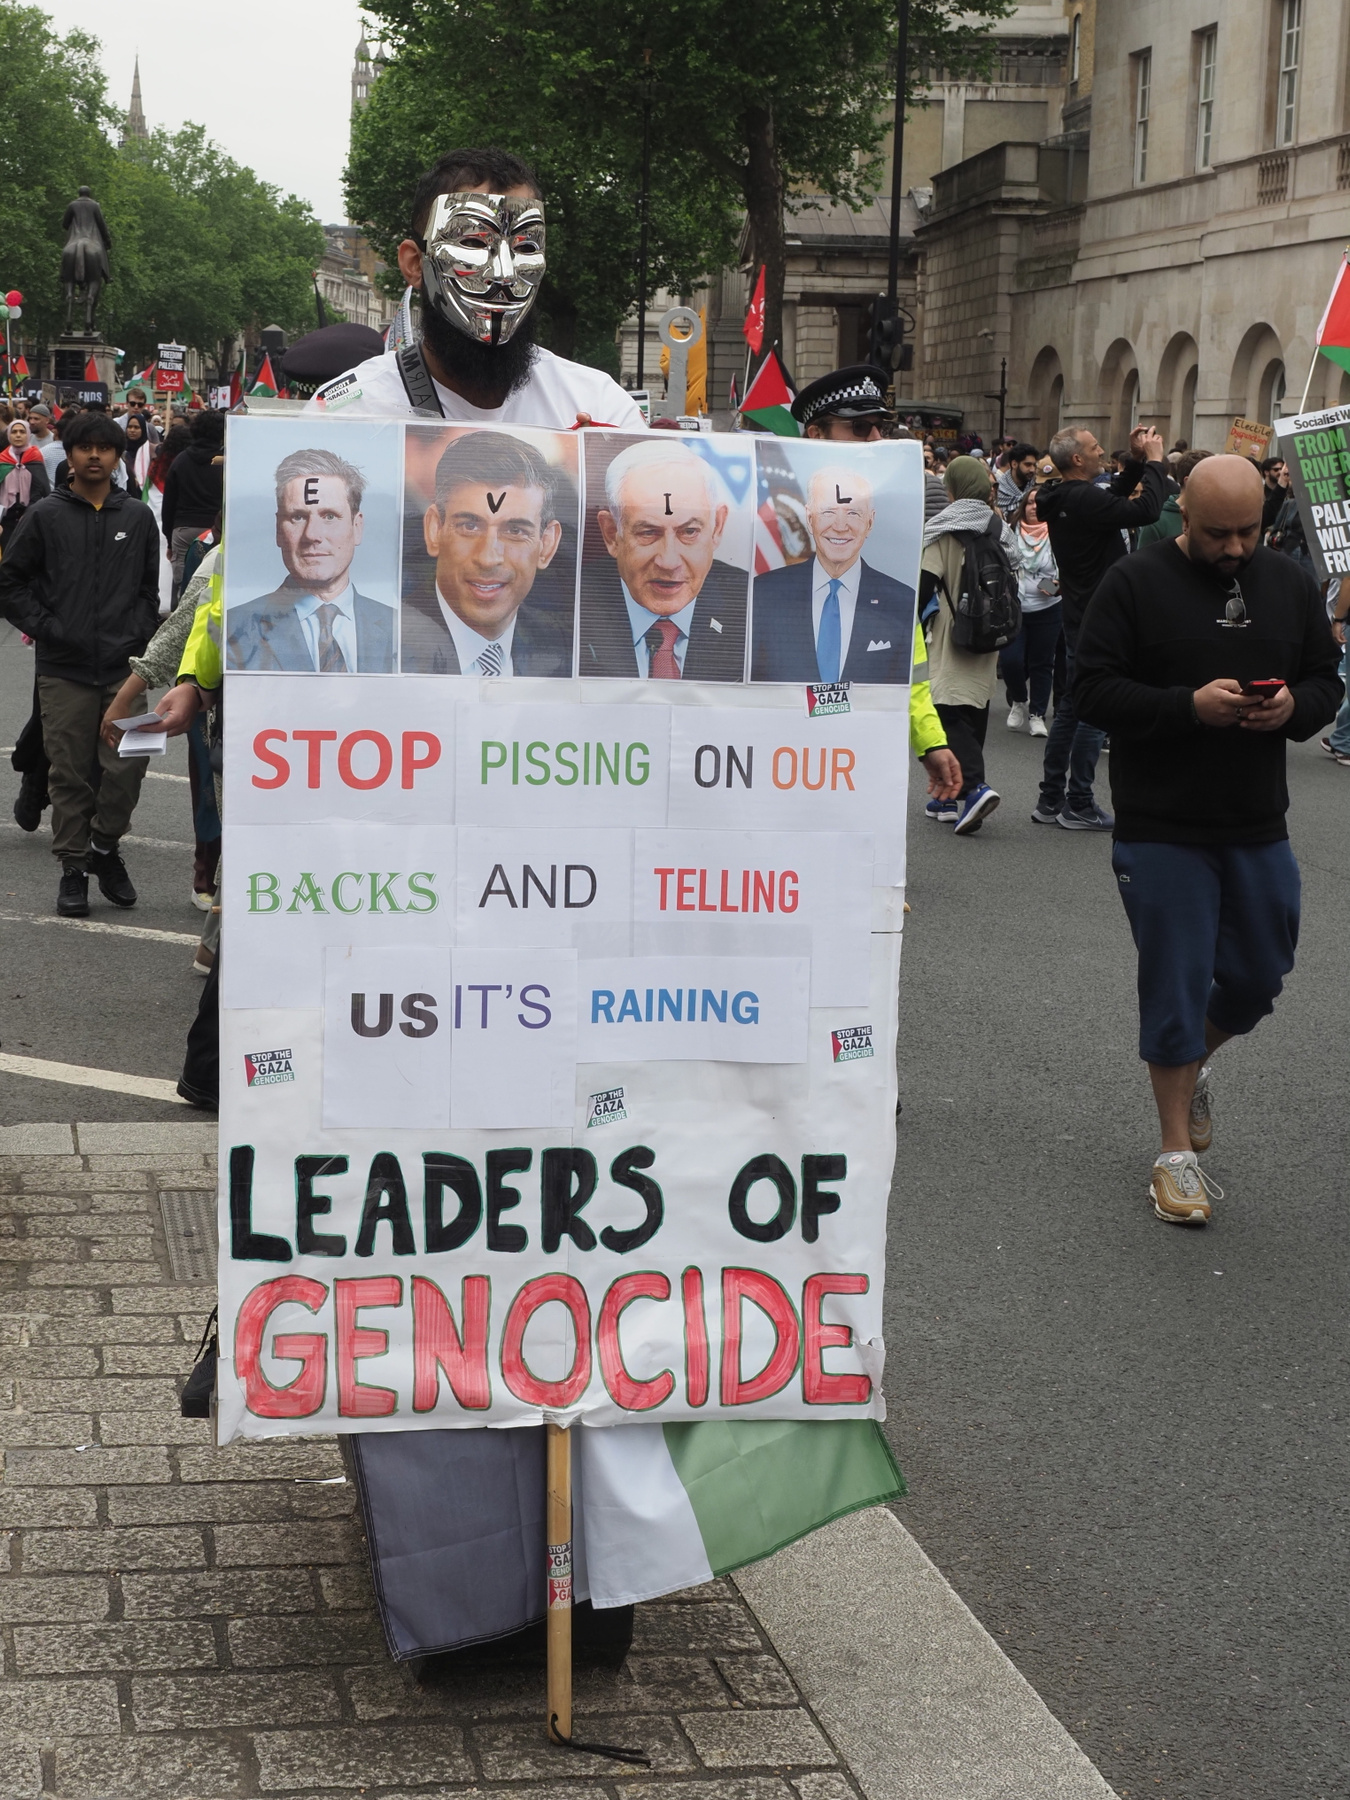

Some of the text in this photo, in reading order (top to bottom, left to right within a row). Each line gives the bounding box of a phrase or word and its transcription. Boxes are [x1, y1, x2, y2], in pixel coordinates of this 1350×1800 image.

[160, 351, 183, 360] FREEDOM
[158, 361, 184, 371] PALESTINE
[324, 380, 350, 397] BOYCOTT
[1234, 418, 1271, 437] Electile
[1293, 427, 1347, 457] FROM
[1300, 451, 1350, 480] RIVER
[304, 478, 853, 516] E V I L
[1304, 478, 1341, 503] THE
[1316, 524, 1350, 550] WIL
[812, 682, 849, 693] STOP THE
[818, 691, 849, 705] GAZA
[815, 704, 850, 715] GENOCIDE
[252, 729, 856, 791] STOP PISSING ON OUR
[246, 864, 799, 914] BACKS AND TELLING
[351, 984, 760, 1038] US IT'S RAINING
[837, 1026, 871, 1039] STOP THE
[843, 1036, 872, 1051] GAZA
[251, 1050, 291, 1063] STOP THE
[839, 1049, 873, 1061] GENOCIDE
[258, 1060, 292, 1075] GAZA
[254, 1073, 294, 1085] GENOCIDE
[593, 1089, 623, 1102] TOP THE
[594, 1099, 624, 1116] GAZA
[591, 1111, 626, 1126] GENOCIDE
[229, 1144, 848, 1261] LEADERS OF
[234, 1265, 874, 1418] GENOCIDE
[548, 1544, 566, 1554] STOP
[554, 1553, 571, 1567] GA
